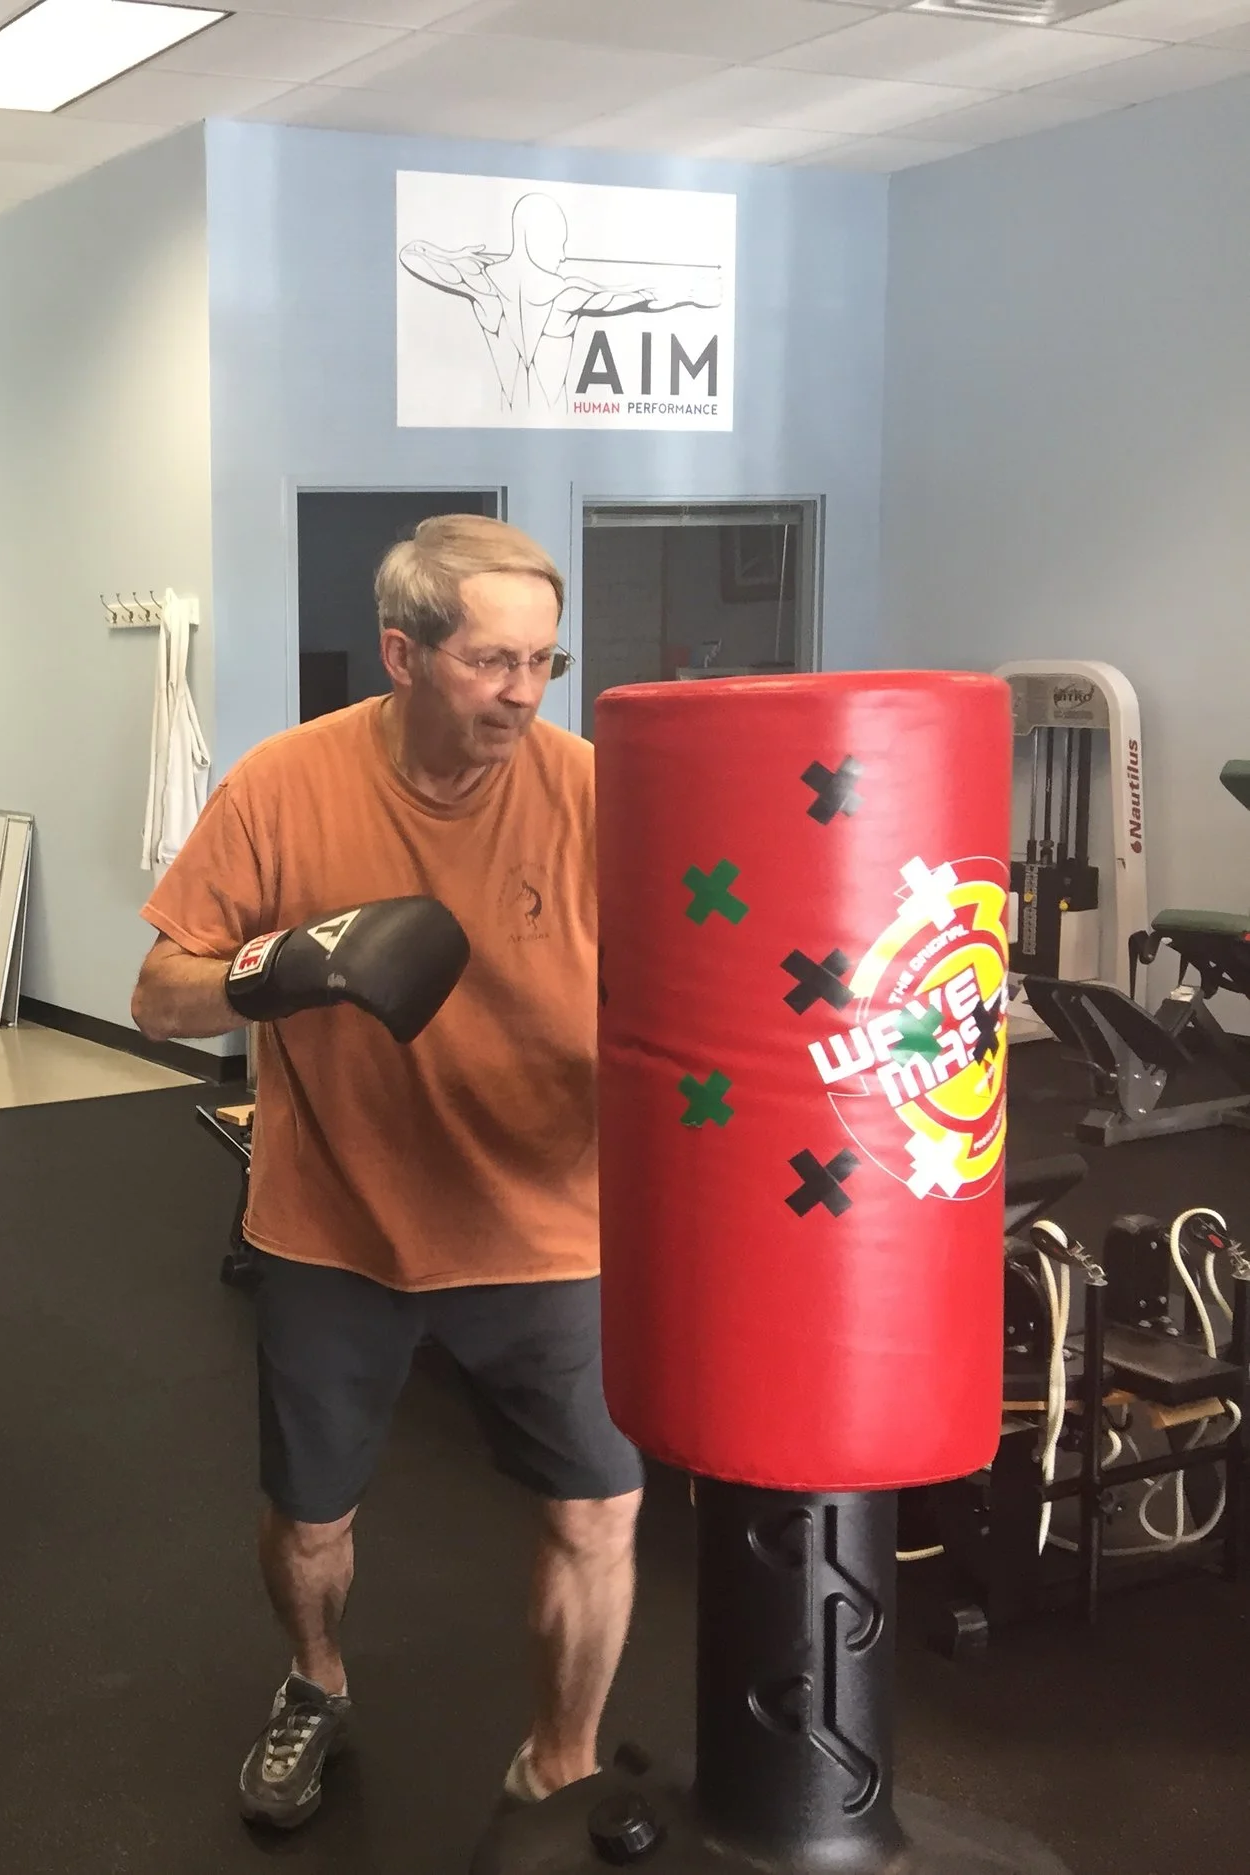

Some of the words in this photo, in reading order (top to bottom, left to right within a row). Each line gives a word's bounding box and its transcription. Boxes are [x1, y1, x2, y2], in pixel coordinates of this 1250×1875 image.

[575, 330, 718, 397] AIM
[573, 401, 620, 414] HUMAN
[627, 402, 718, 416] PERFORMANCE
[1127, 739, 1143, 839] Nautilus
[887, 969, 915, 1005] THE
